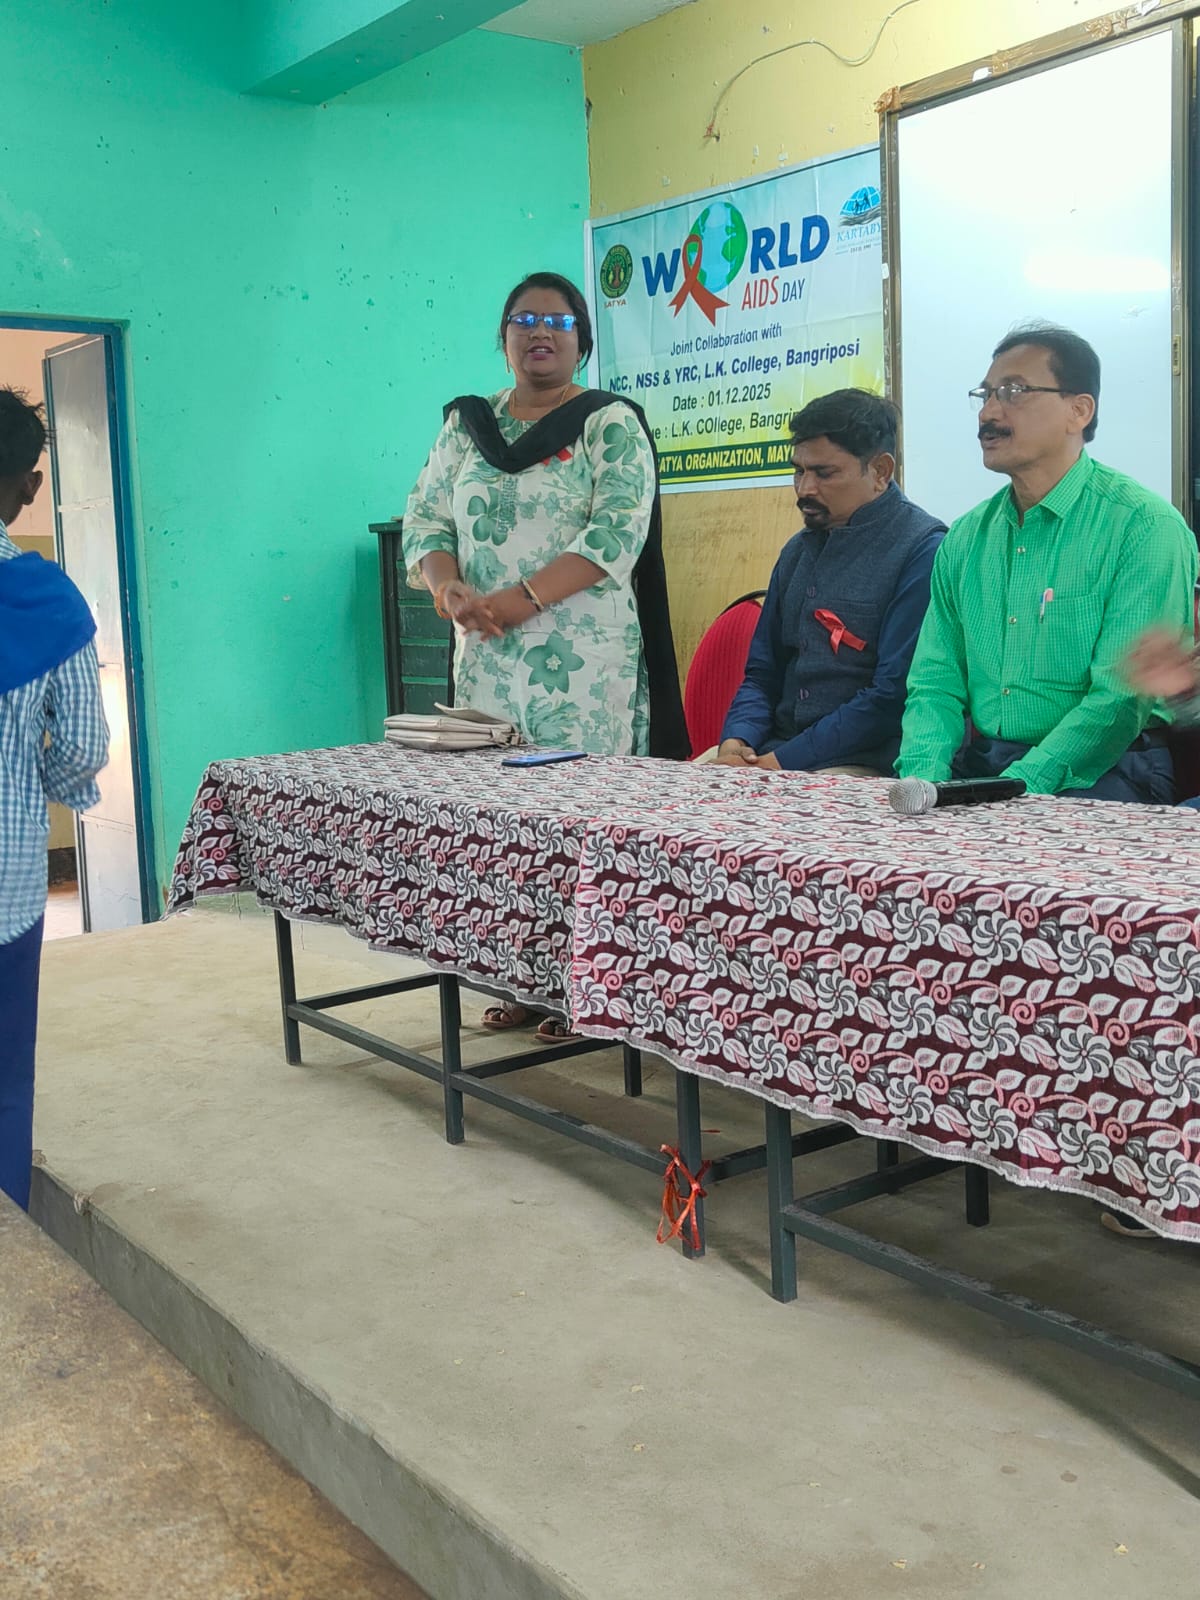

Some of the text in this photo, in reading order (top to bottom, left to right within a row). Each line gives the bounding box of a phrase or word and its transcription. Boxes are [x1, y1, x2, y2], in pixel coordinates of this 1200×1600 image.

[741, 275, 806, 311] AIDS DAY
[670, 322, 782, 357] Joint Collaboration with
[609, 338, 860, 393] NCC, NSS & YRC, L.K. College, Bangriposi
[672, 395, 698, 412] Date
[708, 382, 771, 407] 01.12.2025
[671, 420, 693, 438] L.K.
[750, 406, 797, 430] Bangri
[657, 455, 684, 473] ATYA
[685, 447, 764, 471] ORGANIZATION,
